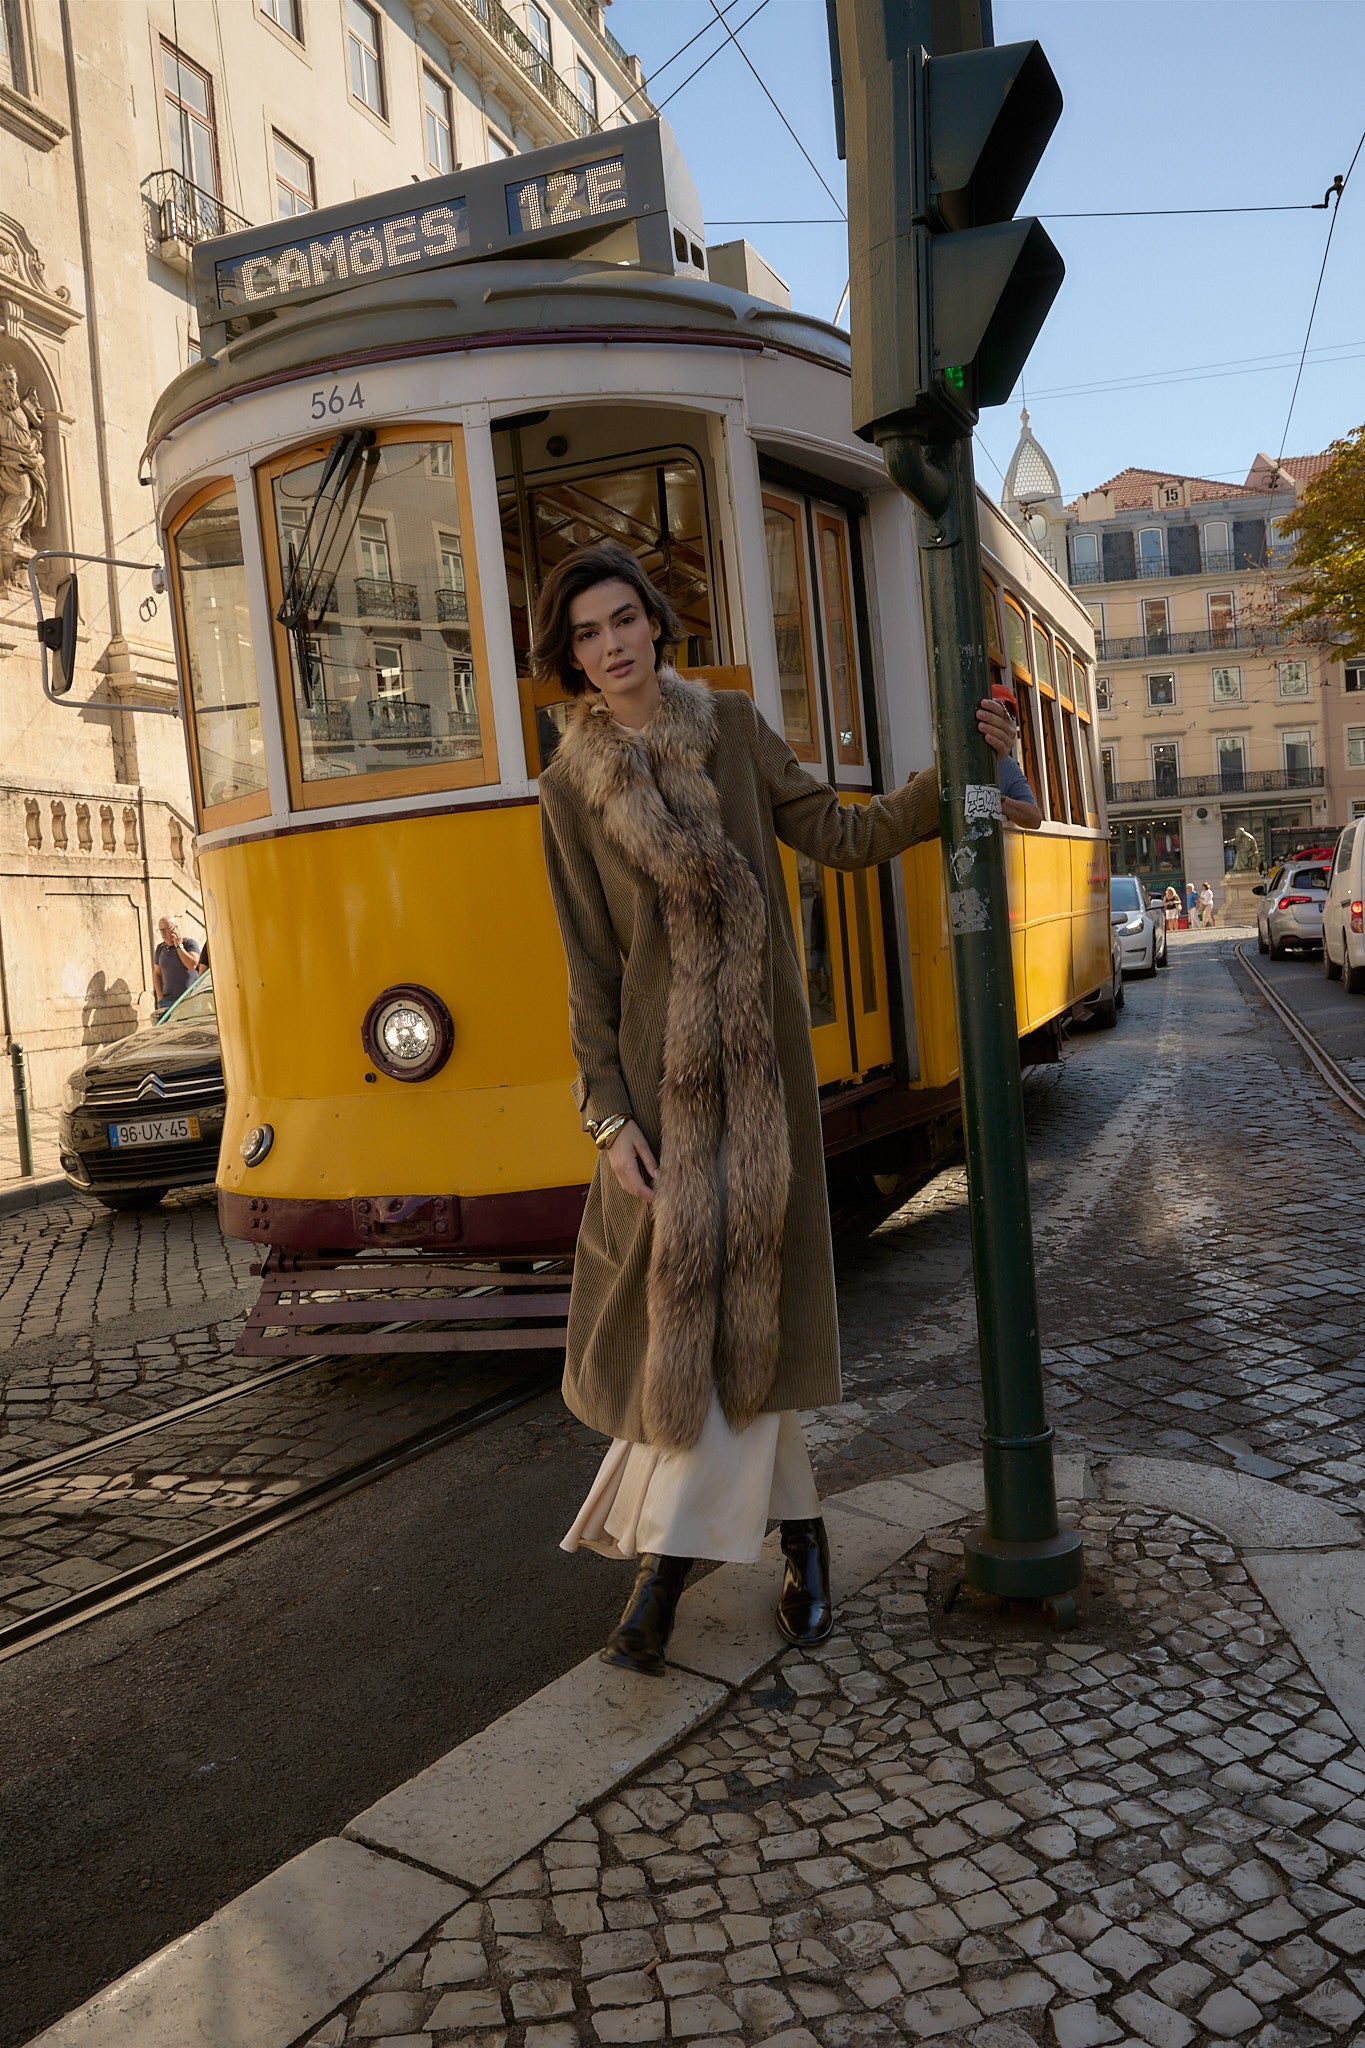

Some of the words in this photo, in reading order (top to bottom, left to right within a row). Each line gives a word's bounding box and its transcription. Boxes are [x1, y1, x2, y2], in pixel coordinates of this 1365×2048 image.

[241, 206, 457, 300] CAMÕES
[519, 161, 626, 230] 12E
[311, 383, 364, 419] 564
[1164, 488, 1178, 501] 15
